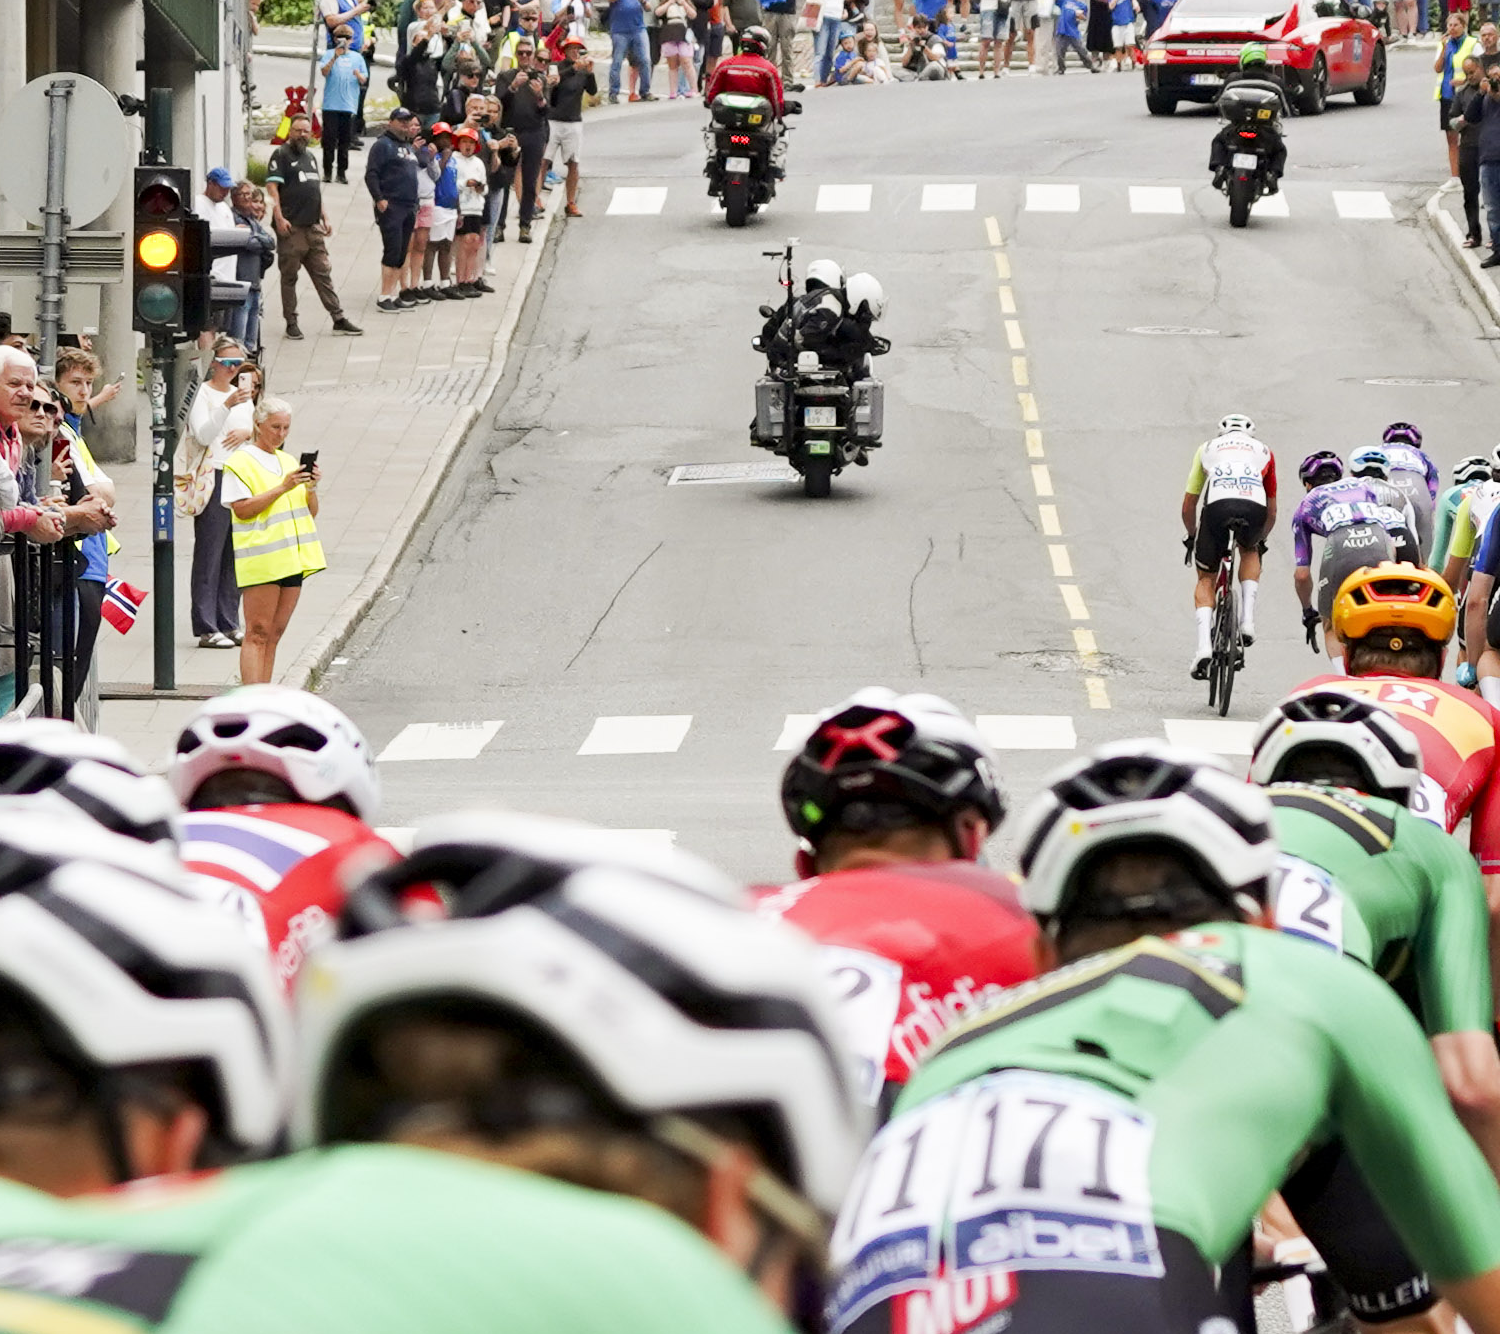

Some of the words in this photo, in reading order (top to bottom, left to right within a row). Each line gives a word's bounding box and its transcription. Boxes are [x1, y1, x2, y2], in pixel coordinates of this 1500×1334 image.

[1343, 535, 1379, 548] ALULA
[979, 1099, 1125, 1202] 171
[969, 1219, 1131, 1263] aibel
